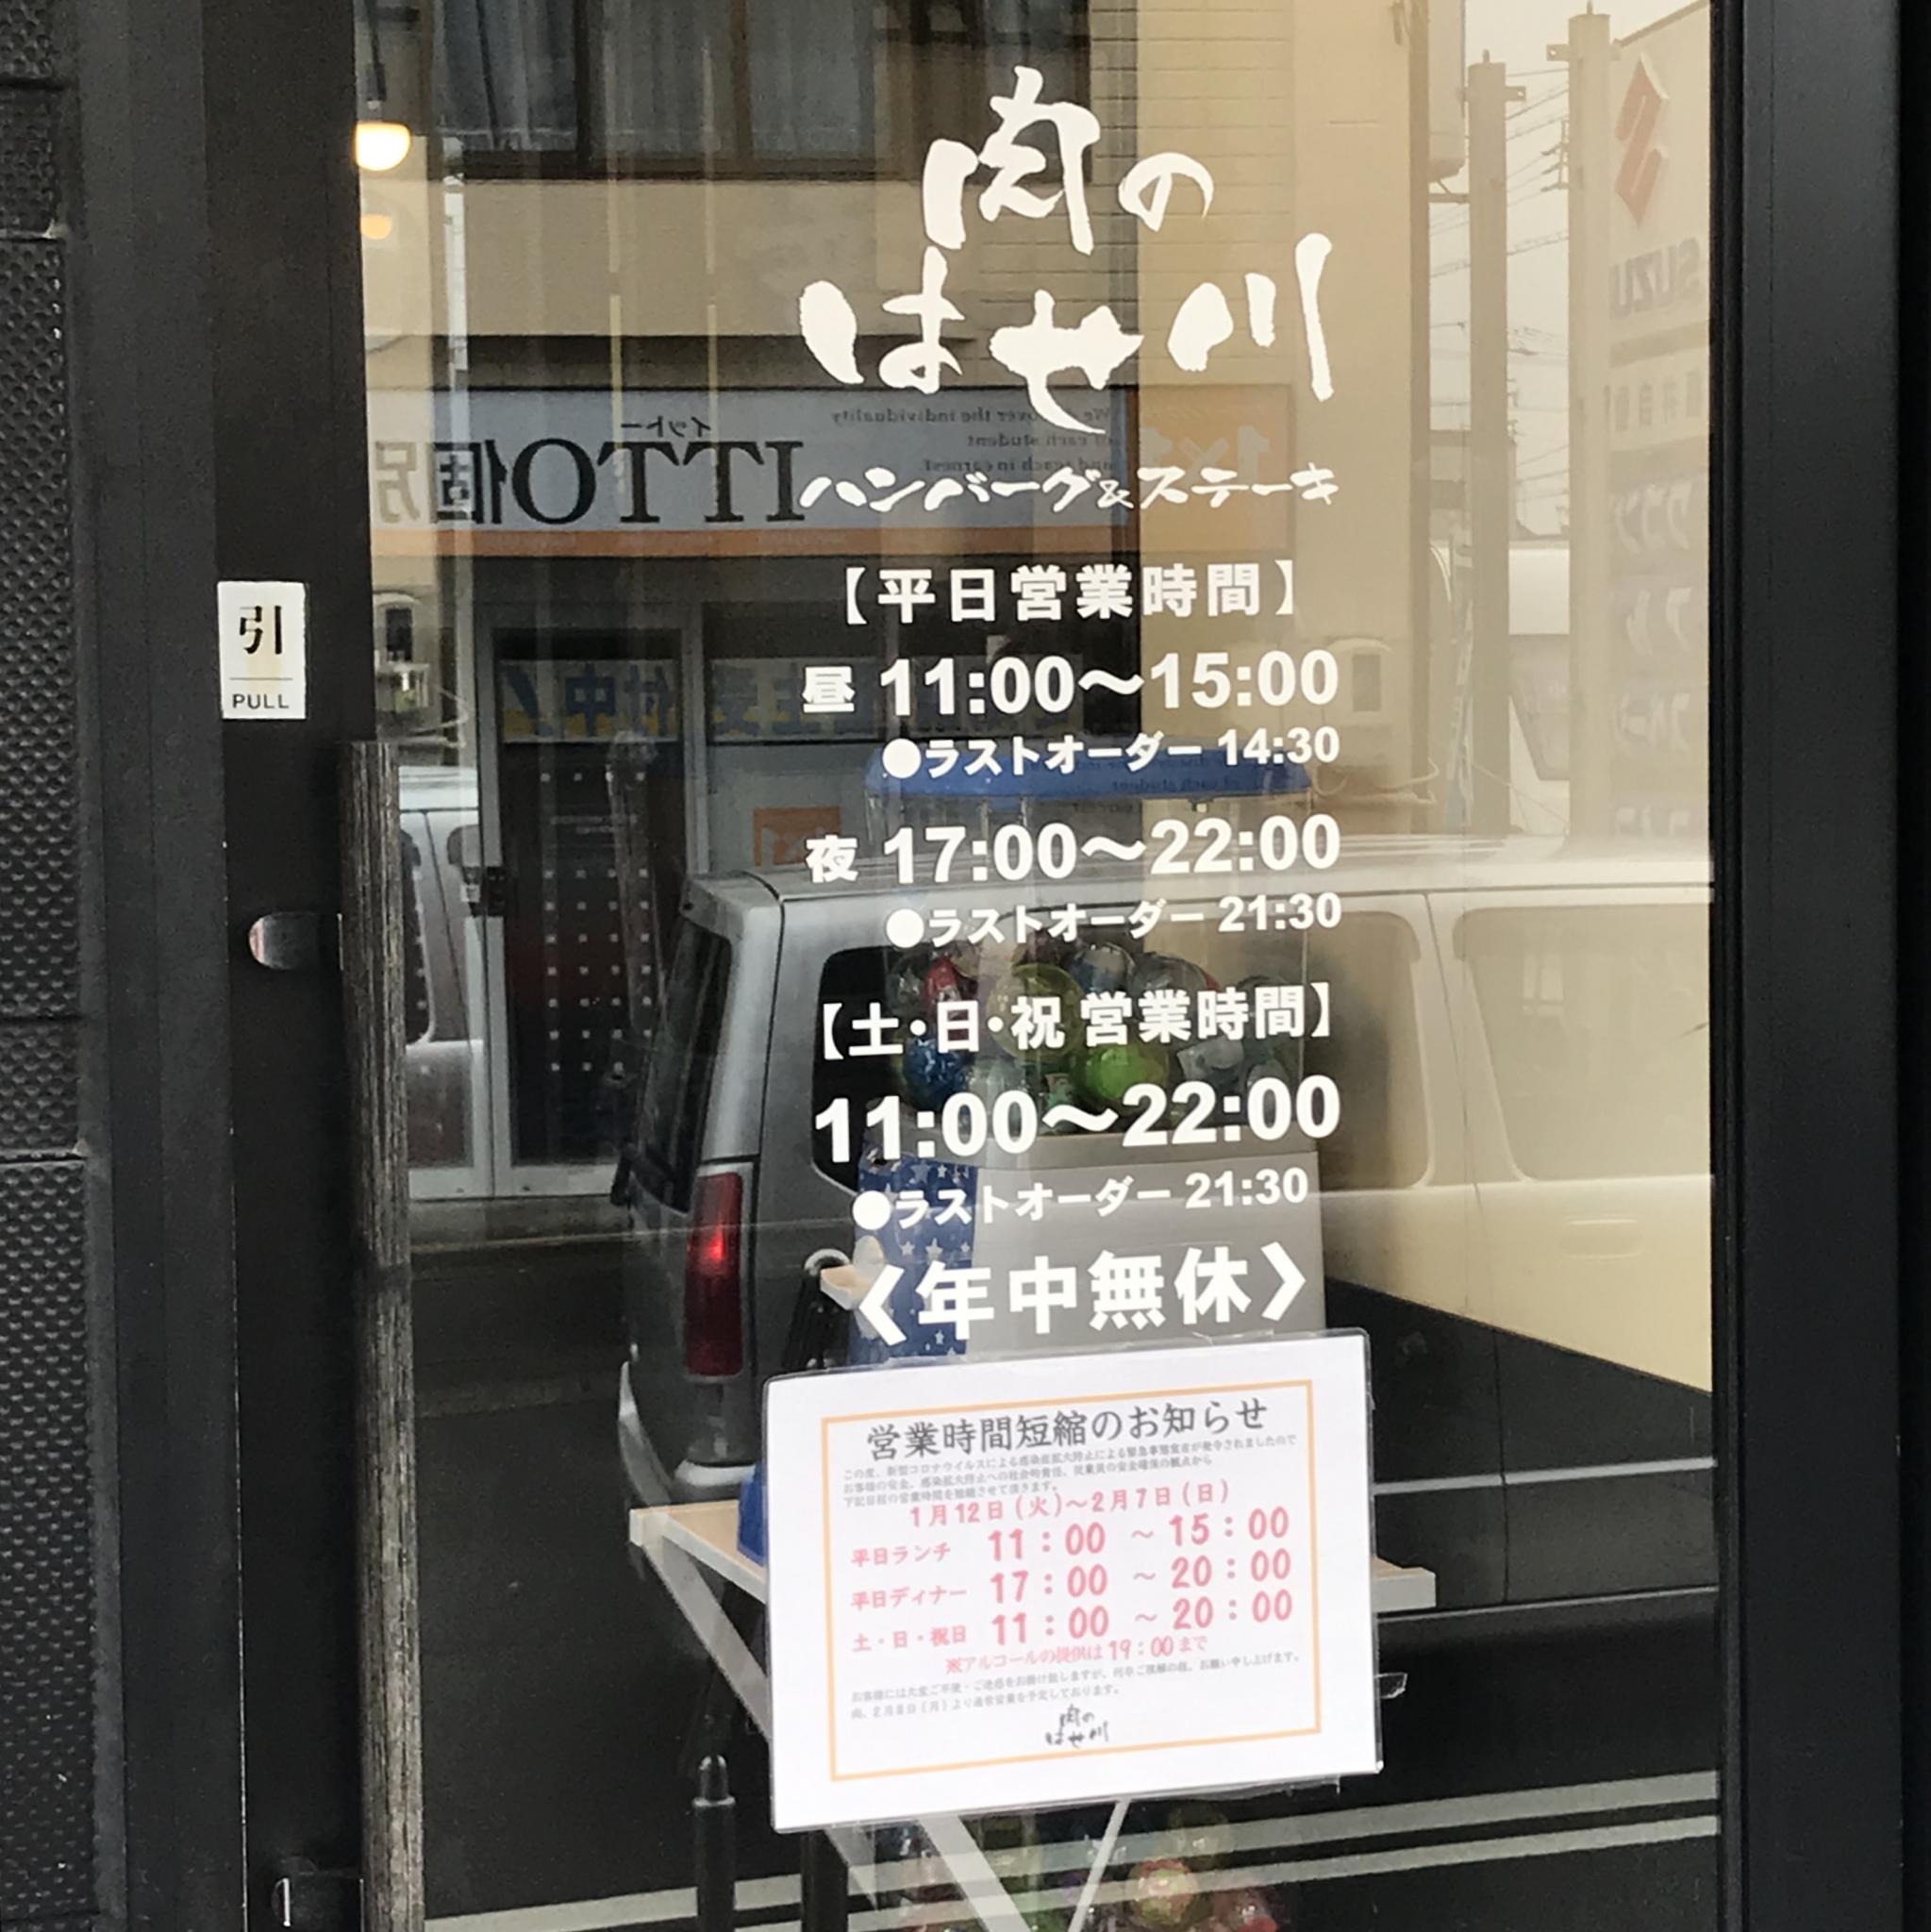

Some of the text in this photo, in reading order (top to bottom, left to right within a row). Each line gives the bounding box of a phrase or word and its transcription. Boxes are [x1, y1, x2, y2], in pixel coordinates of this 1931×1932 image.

[922, 64, 1215, 256] 肉の
[799, 232, 1335, 434] はせ川
[238, 604, 284, 655] 引
[232, 692, 290, 709] PULL
[803, 666, 856, 714] 昼
[1217, 726, 1340, 766] 14:30
[806, 834, 858, 883] 夜
[1218, 892, 1342, 933] 21:30
[1185, 1167, 1309, 1209] 21:30
[866, 1397, 1268, 1461] 営業時間短縮のお知らせ
